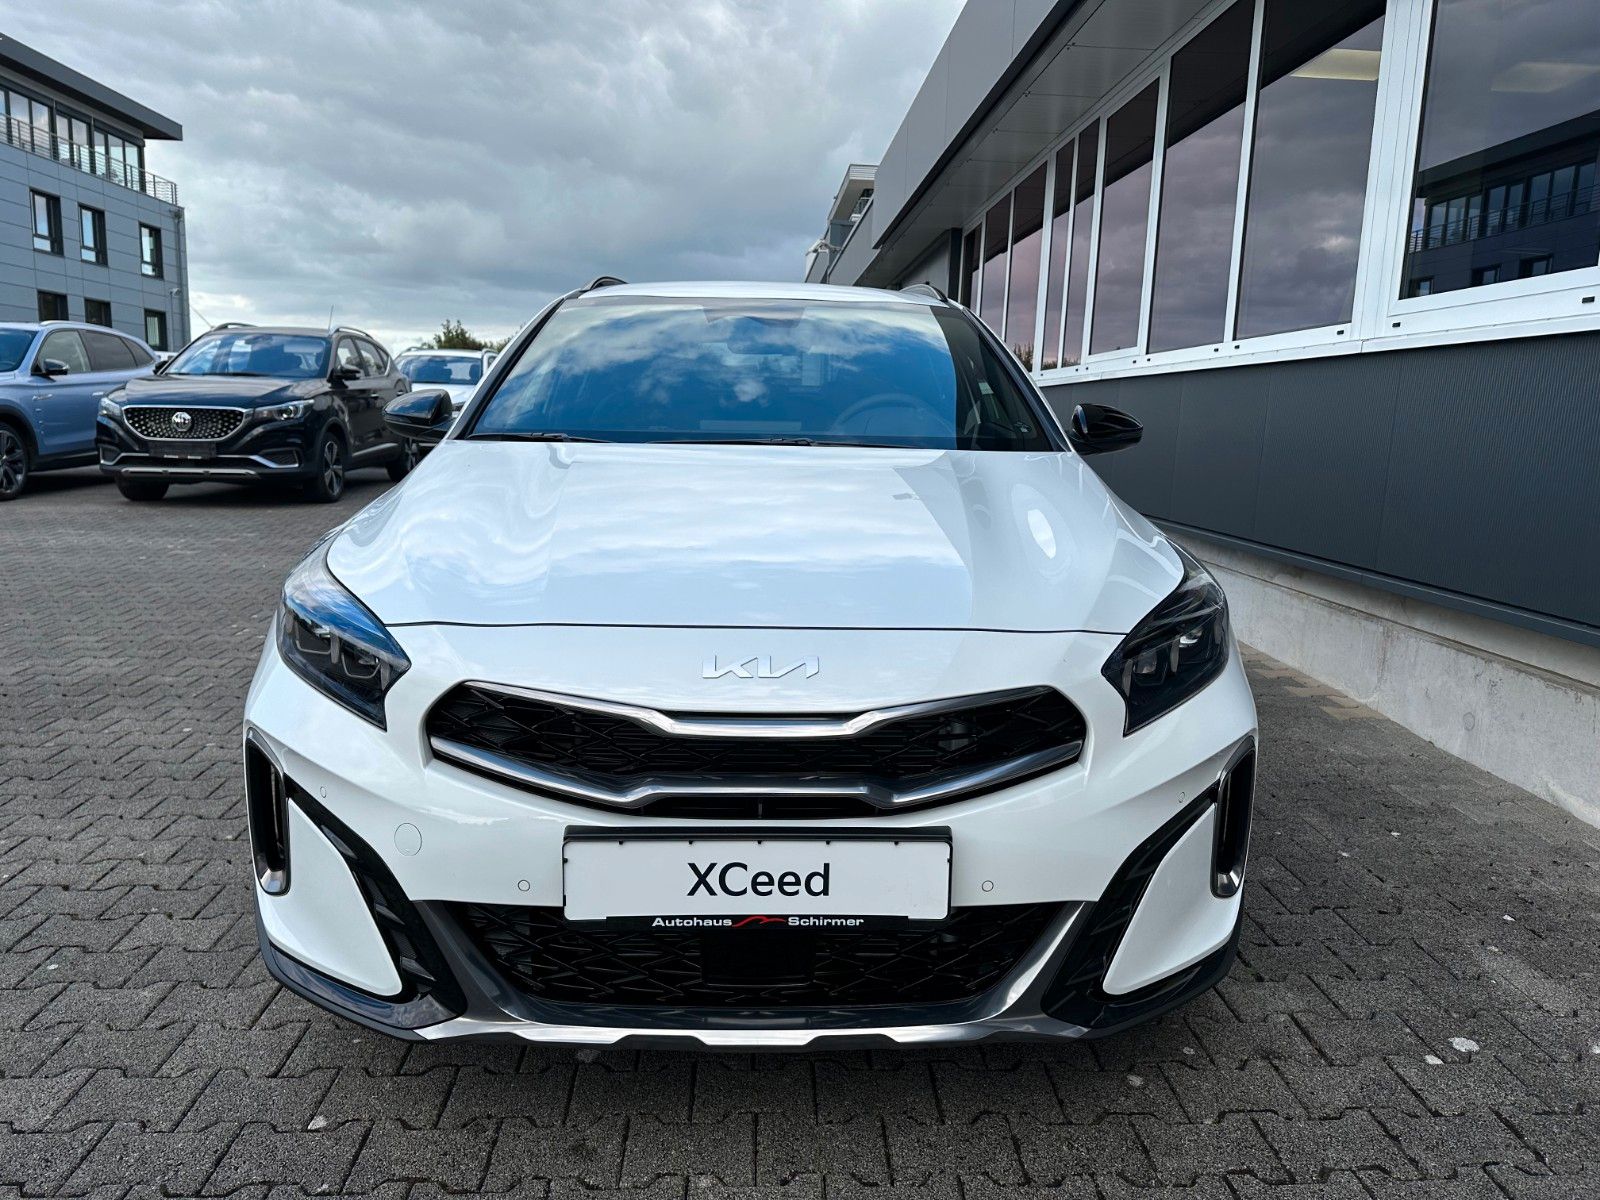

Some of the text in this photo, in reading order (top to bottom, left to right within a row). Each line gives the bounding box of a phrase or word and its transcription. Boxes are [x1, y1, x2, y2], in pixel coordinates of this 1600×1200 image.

[702, 655, 820, 680] KIA
[687, 862, 831, 897] XCeed
[652, 916, 865, 927] Autohaus Schirmer
